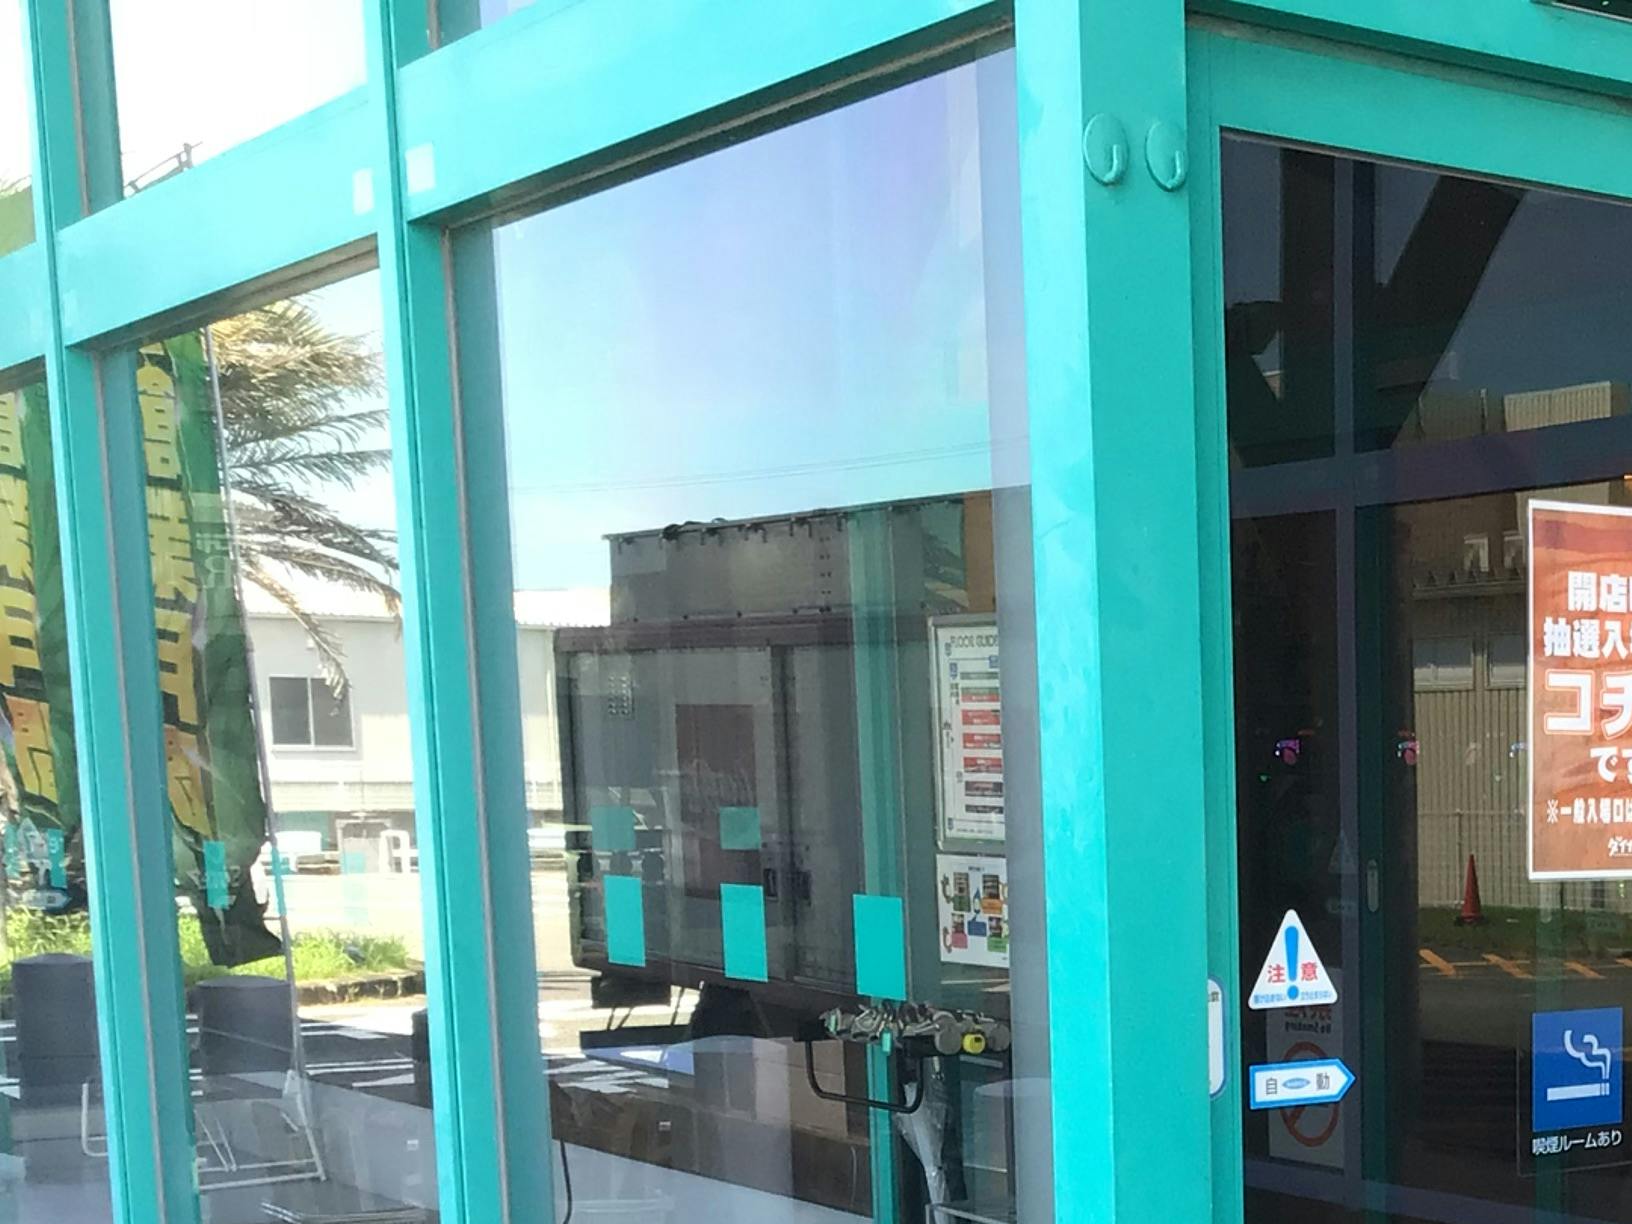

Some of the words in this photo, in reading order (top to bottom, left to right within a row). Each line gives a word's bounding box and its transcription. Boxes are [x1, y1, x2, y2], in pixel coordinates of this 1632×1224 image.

[1532, 1129, 1622, 1155] 喫煙ルームあり
